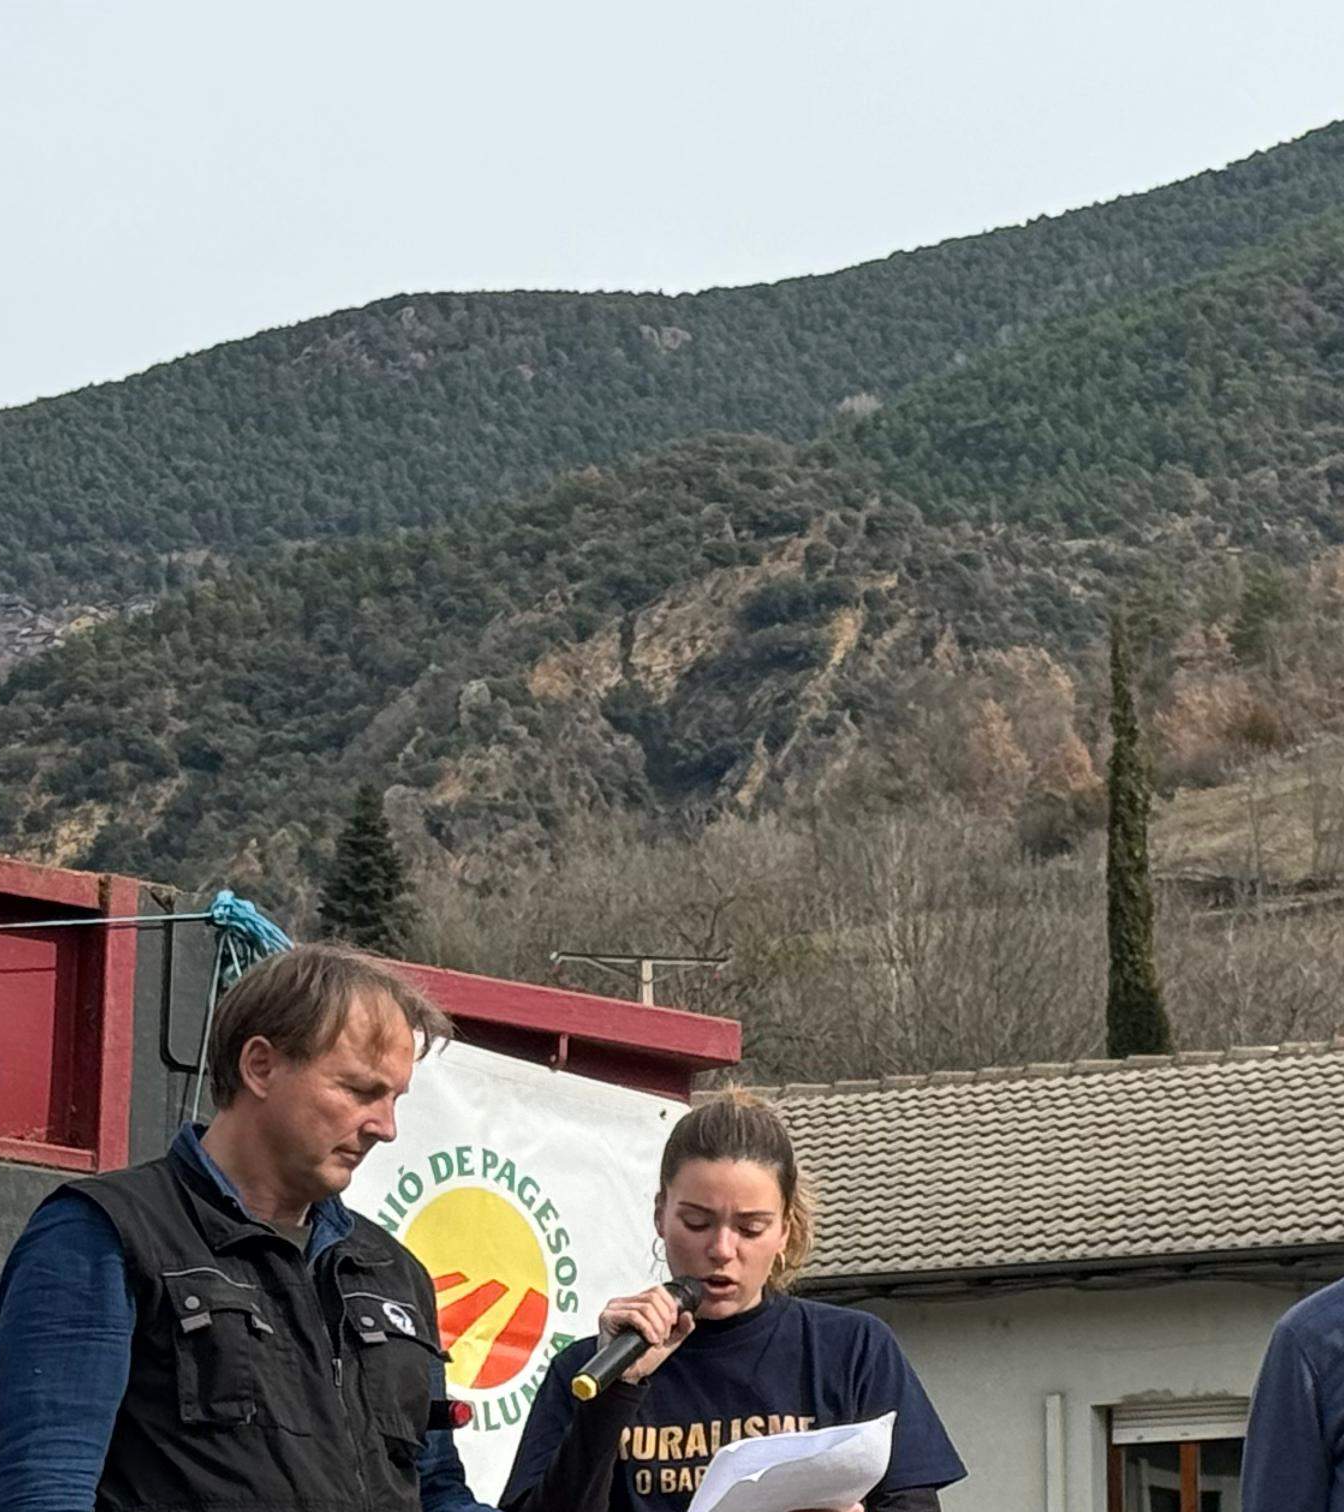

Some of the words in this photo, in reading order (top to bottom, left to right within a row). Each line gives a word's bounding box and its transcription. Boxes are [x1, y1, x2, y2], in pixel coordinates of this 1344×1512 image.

[376, 1164, 424, 1236] NIÓ
[428, 1145, 475, 1186] DE
[482, 1147, 579, 1314] PAGESOS
[635, 1468, 652, 1496] O
